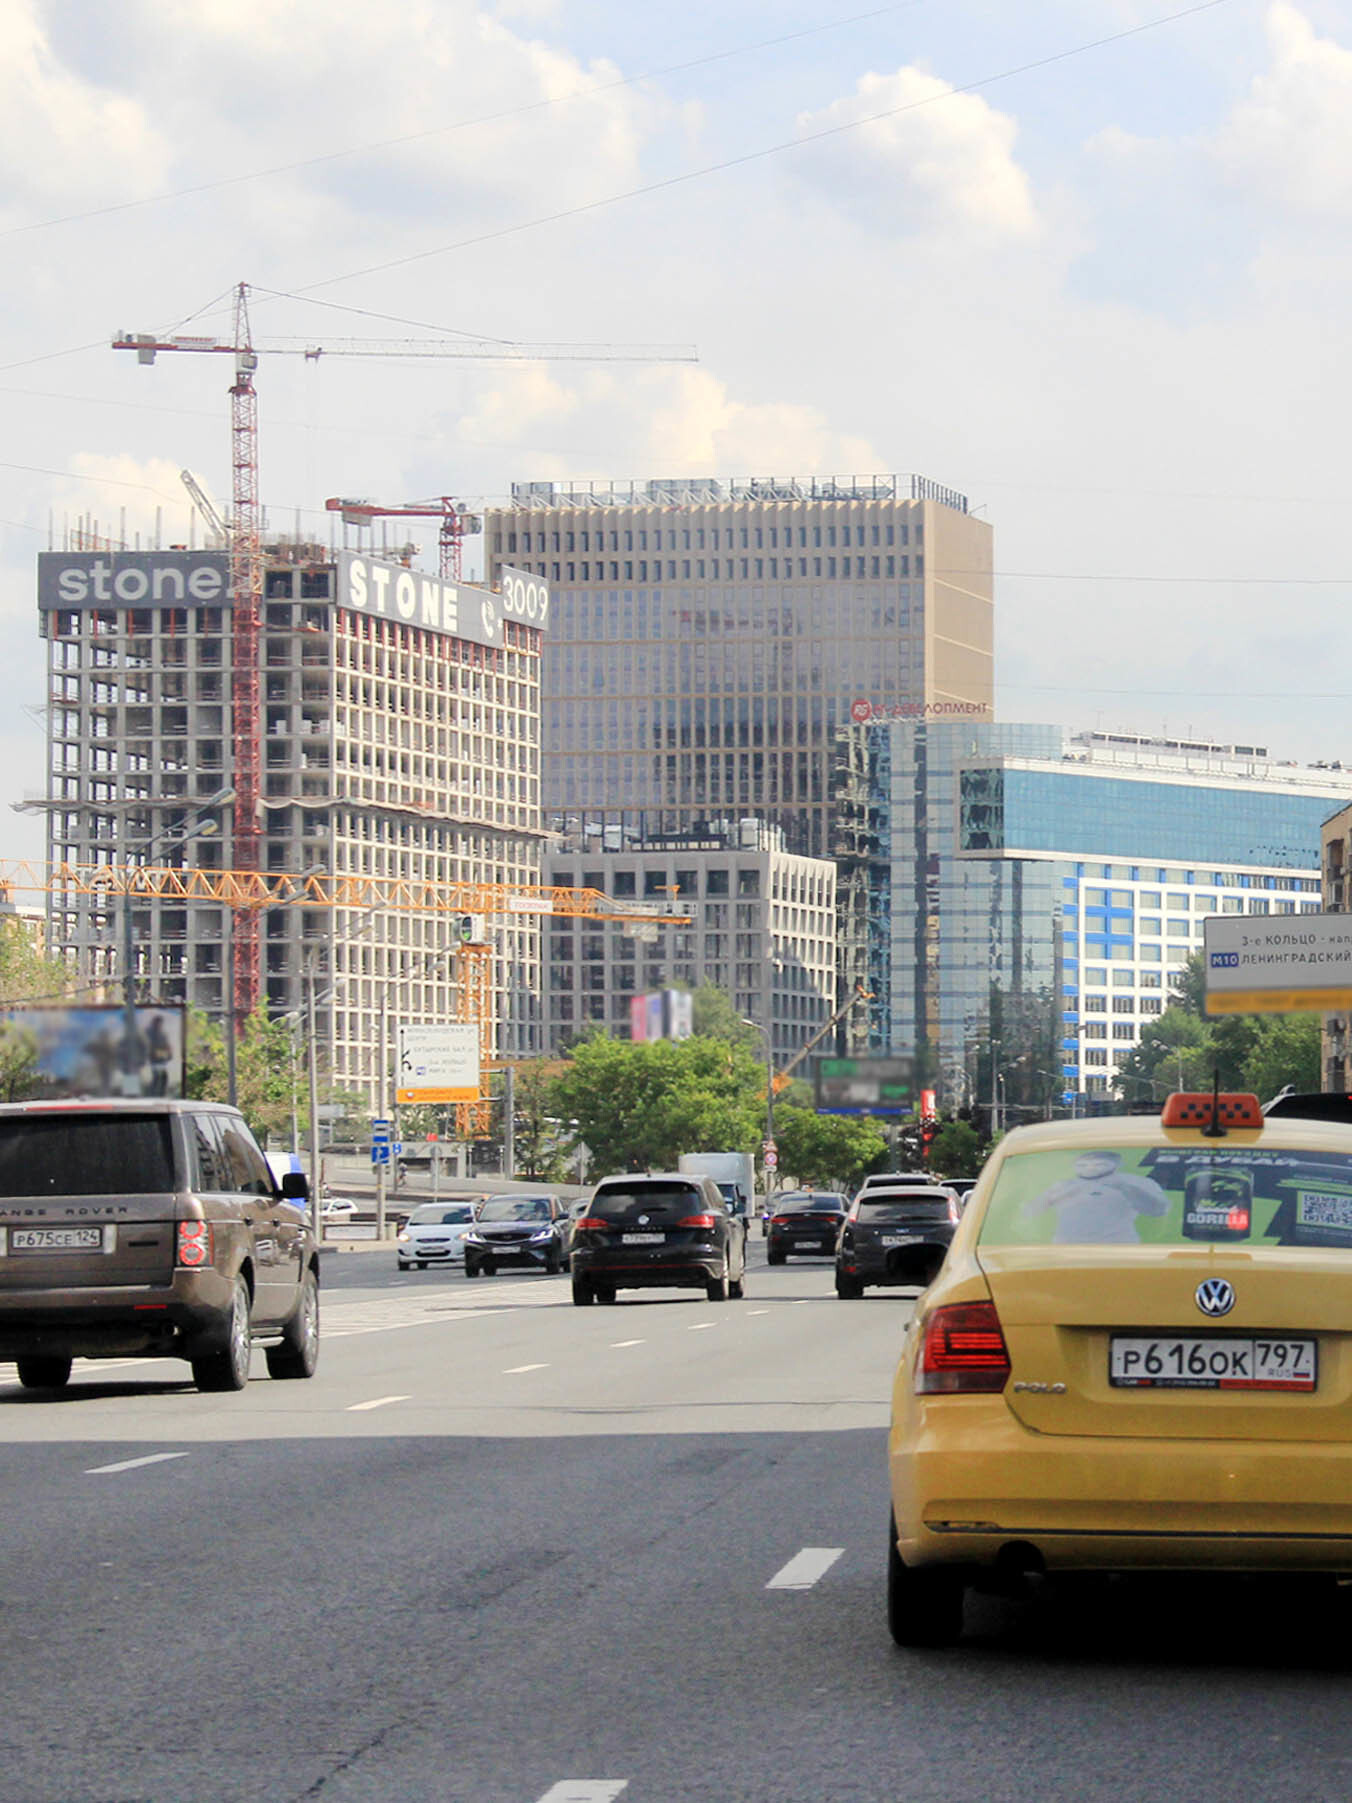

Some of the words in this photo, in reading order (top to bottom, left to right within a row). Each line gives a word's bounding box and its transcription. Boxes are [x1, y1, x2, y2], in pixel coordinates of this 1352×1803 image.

[349, 559, 458, 633] STONE
[1241, 935, 1262, 947] 3-е
[1265, 933, 1317, 946] КОЛЬЦО
[1211, 953, 1239, 967] М10
[1240, 949, 1352, 966] ЛЕНИНГРАДСКИЙ
[65, 1206, 128, 1215] ROVER
[1186, 1211, 1248, 1225] GORILLA
[1123, 1343, 1249, 1376] Р616ОК
[1257, 1344, 1304, 1368] 797
[1013, 1382, 1067, 1395] POLO
